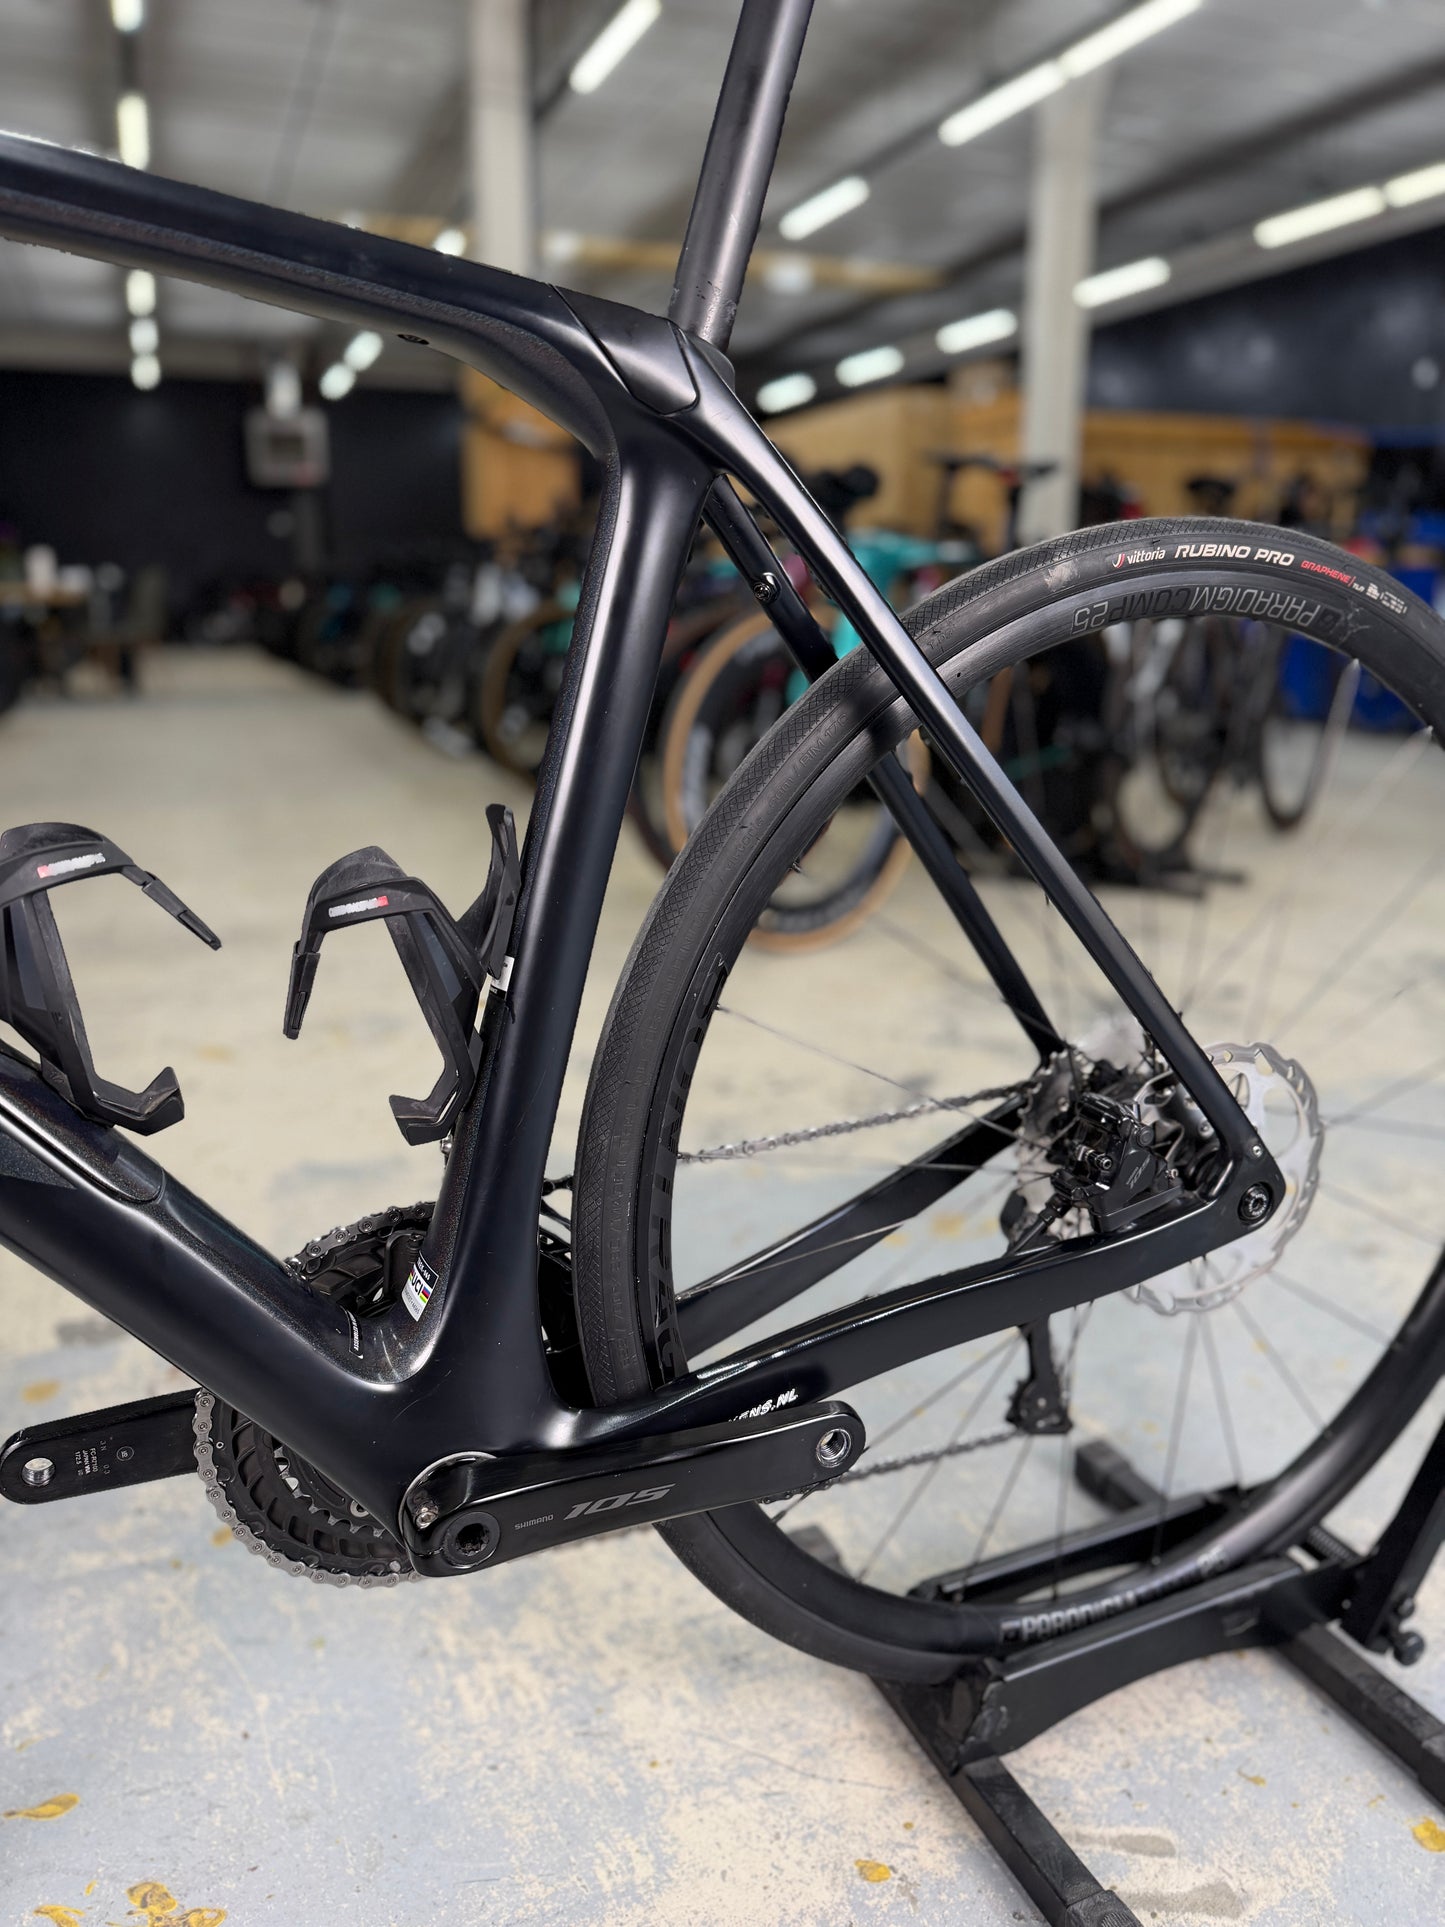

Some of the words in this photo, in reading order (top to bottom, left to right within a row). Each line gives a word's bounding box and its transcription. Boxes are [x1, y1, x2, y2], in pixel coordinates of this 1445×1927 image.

[1127, 547, 1166, 564] vittoria
[1174, 544, 1251, 559] RUBINO
[1254, 549, 1295, 566] PRO
[1301, 560, 1351, 583] GRAPHENE
[1189, 586, 1321, 627] PARADIGM
[411, 1273, 423, 1297] UCI
[729, 1388, 798, 1422] ENS.NL
[514, 1514, 554, 1531] SHIMANO
[563, 1483, 677, 1521] 105
